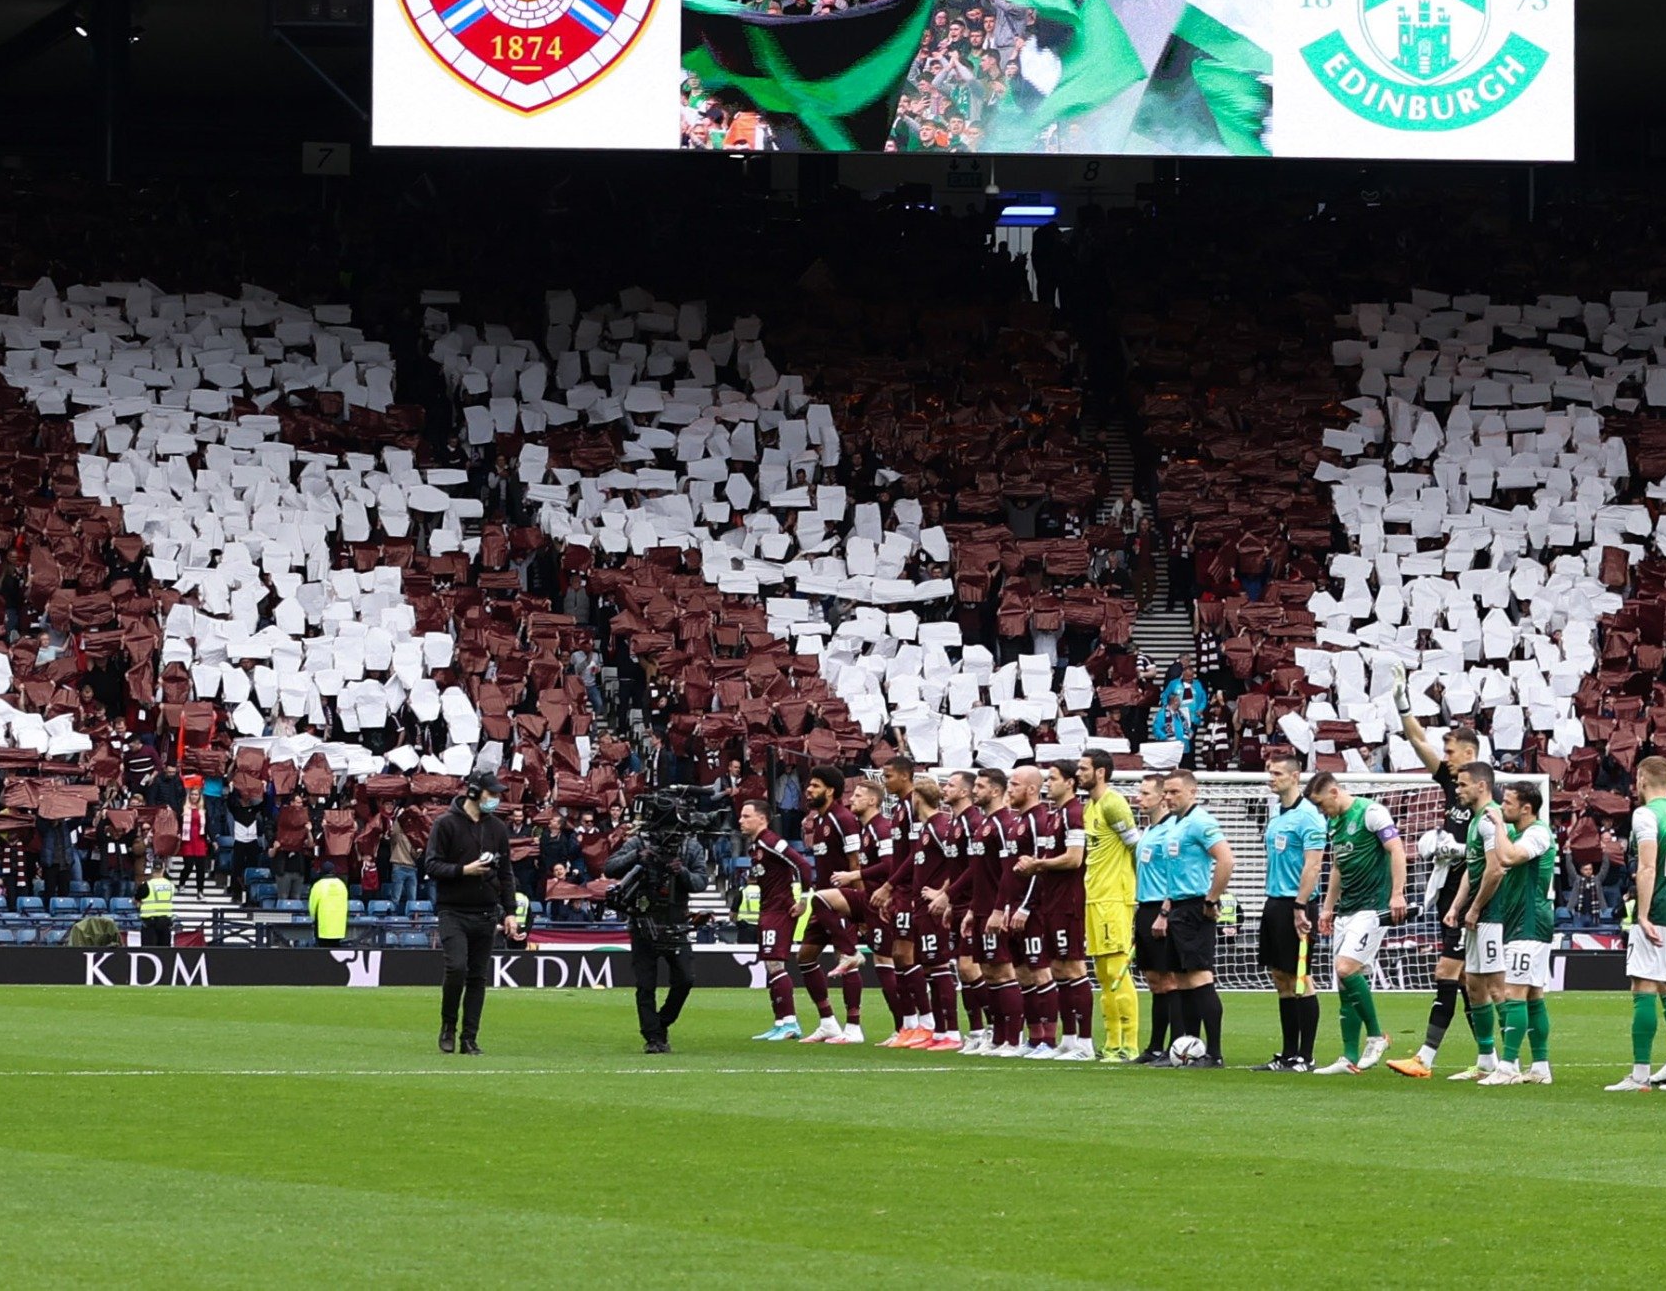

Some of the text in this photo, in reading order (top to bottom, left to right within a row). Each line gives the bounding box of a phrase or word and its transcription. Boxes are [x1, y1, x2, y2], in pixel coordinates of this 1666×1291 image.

[490, 35, 563, 61] 1874
[1322, 52, 1528, 122] EDINBURGH
[318, 148, 333, 168] 7
[1083, 160, 1100, 181] 8
[895, 912, 911, 929] 21
[762, 930, 777, 945] 18
[873, 928, 882, 944] 3
[1056, 929, 1068, 947] 5
[1104, 923, 1110, 940] 1
[1359, 932, 1370, 948] 4
[921, 934, 938, 952] 12
[982, 933, 997, 951] 19
[1024, 937, 1042, 955] 10
[1486, 940, 1497, 958] 6
[83, 952, 209, 987] KDM
[1511, 953, 1531, 971] 16
[490, 955, 614, 989] KDM
